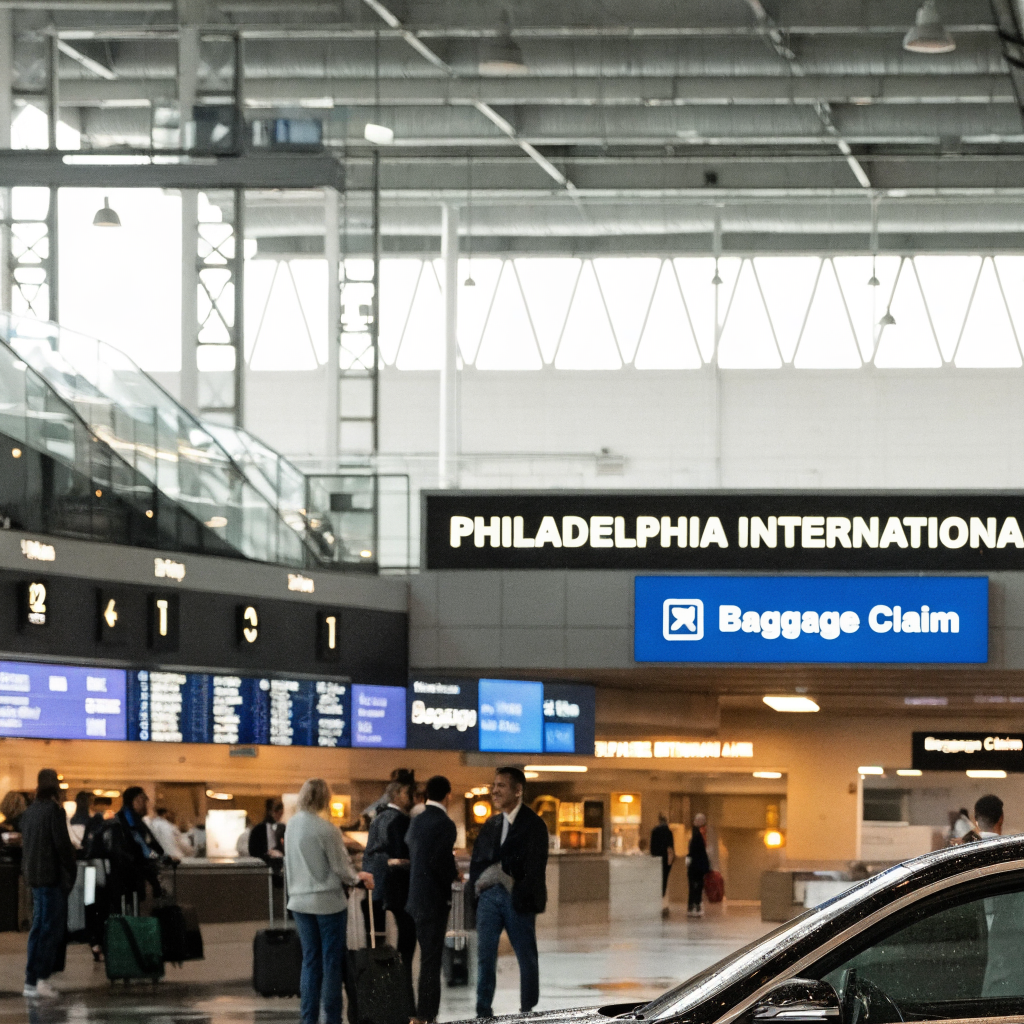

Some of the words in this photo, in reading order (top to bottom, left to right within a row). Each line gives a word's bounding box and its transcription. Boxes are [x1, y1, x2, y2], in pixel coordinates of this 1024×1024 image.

[449, 515, 729, 549] PHILADELPHIA
[718, 604, 861, 640] Baggage
[867, 604, 960, 633] Claim
